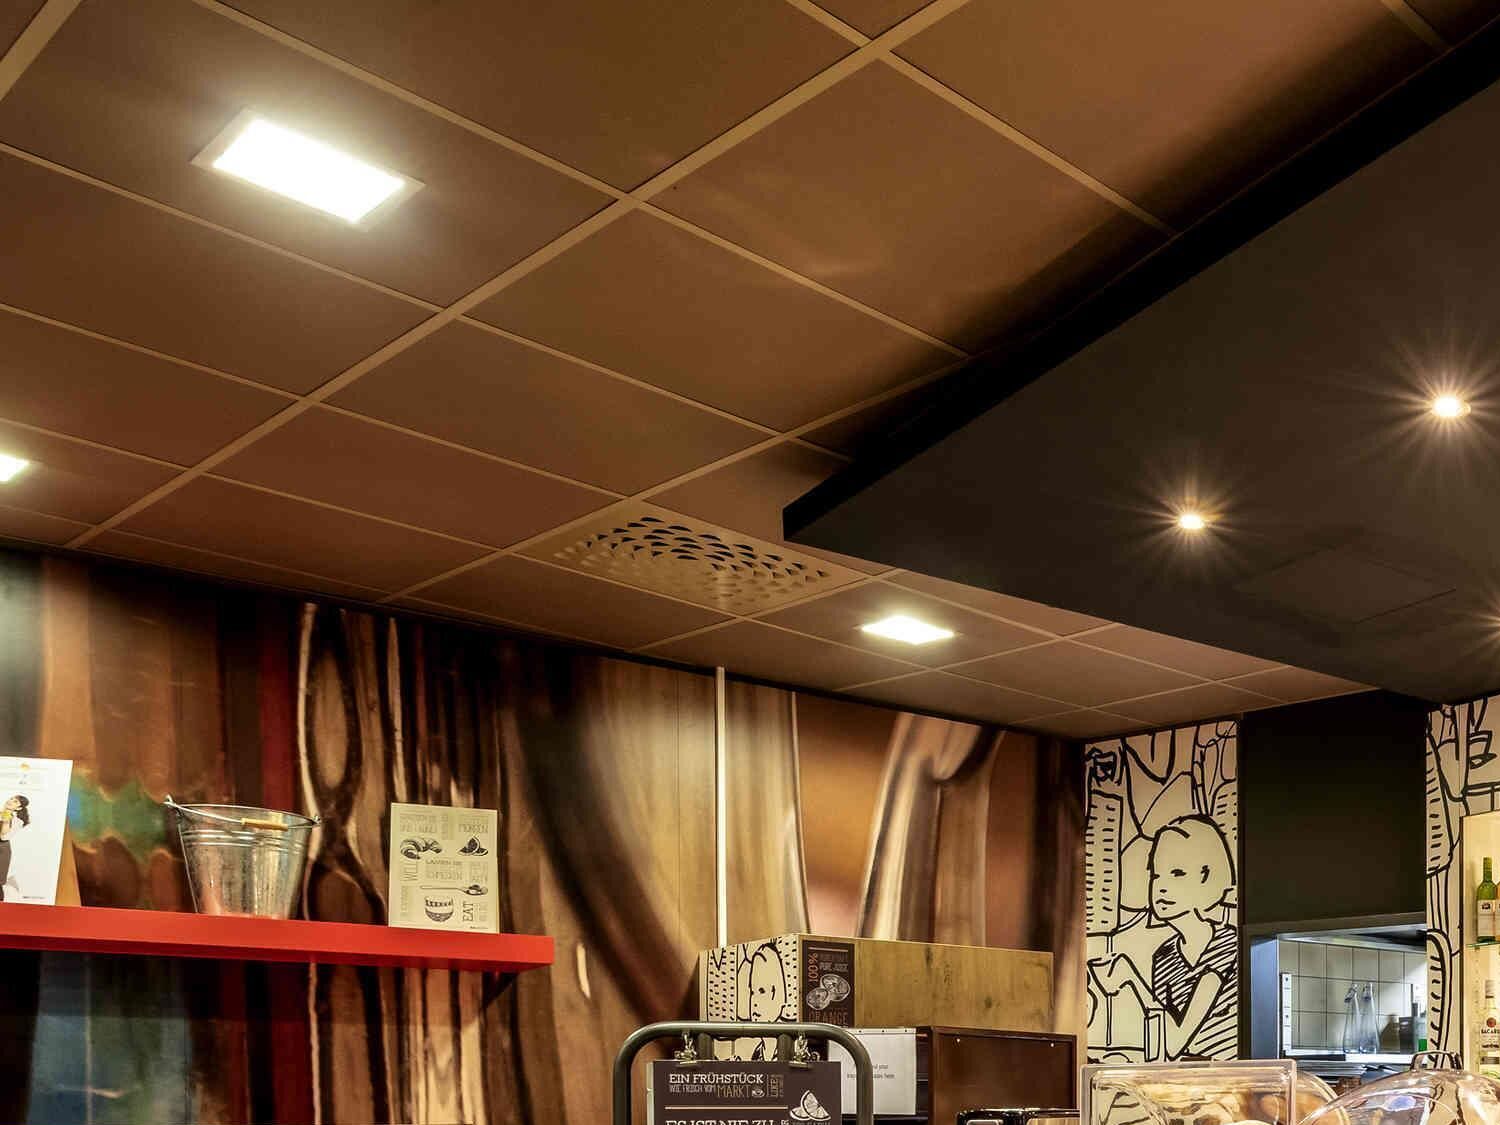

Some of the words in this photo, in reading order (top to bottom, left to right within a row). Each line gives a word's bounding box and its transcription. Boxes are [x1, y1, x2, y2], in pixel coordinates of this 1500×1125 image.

[808, 953, 818, 982] 100%
[669, 1073, 690, 1084] EIN
[692, 1071, 764, 1084] FRÜHSTÜCK
[717, 1084, 751, 1098] MARKT
